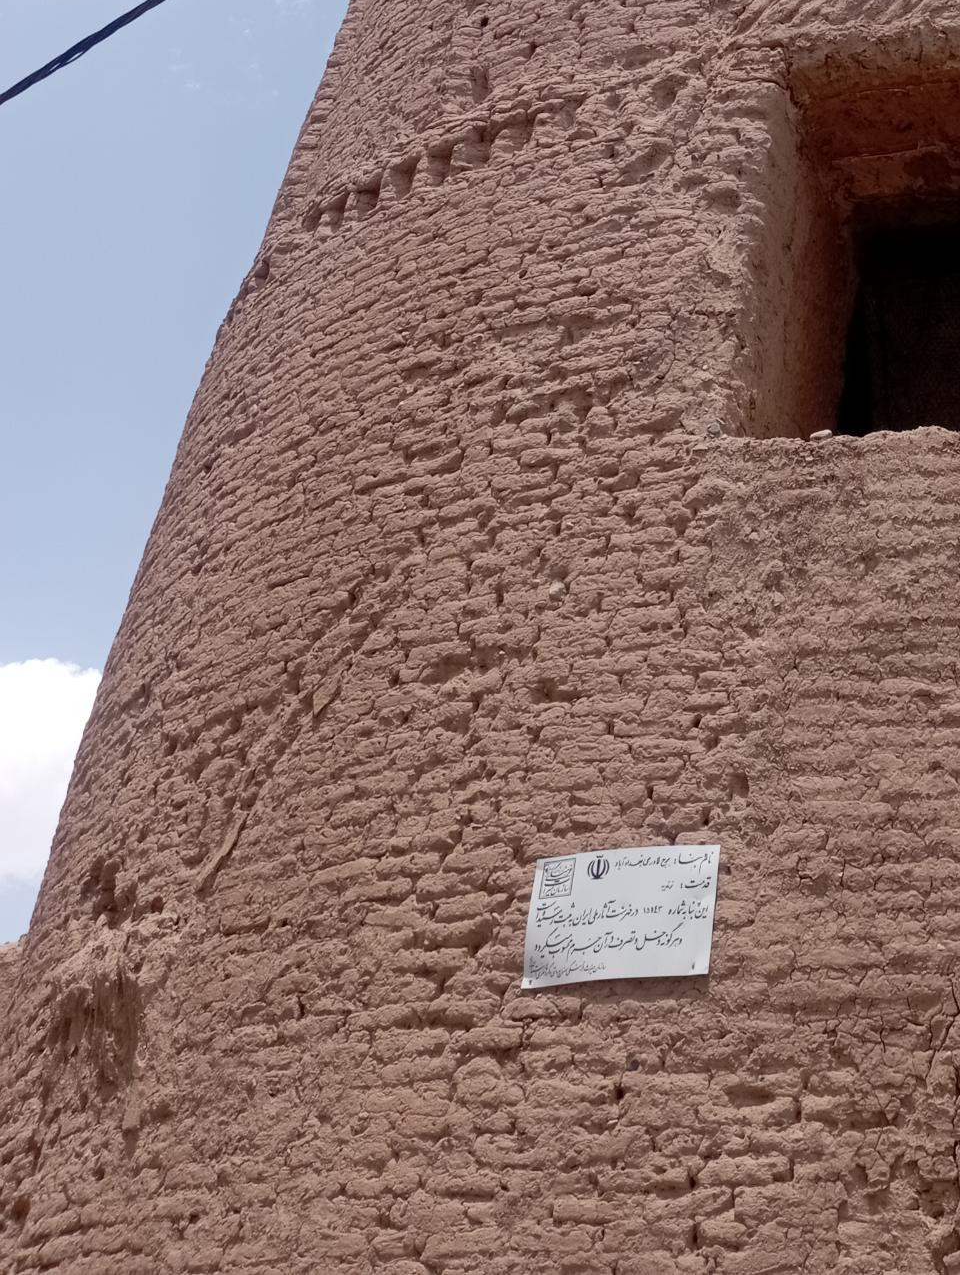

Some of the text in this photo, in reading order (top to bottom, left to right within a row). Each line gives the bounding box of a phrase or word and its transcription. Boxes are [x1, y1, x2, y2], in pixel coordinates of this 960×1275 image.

[553, 902, 575, 927] ثبت
[597, 899, 616, 919] آثار
[606, 903, 633, 922] فهرست
[631, 908, 639, 917] در
[667, 899, 686, 915] شماره
[694, 901, 709, 919] این
[572, 908, 593, 926] ایران
[549, 939, 573, 958] محسوب
[566, 936, 602, 960] جرم
[608, 930, 636, 950] تصرف
[636, 930, 667, 951] دخل
